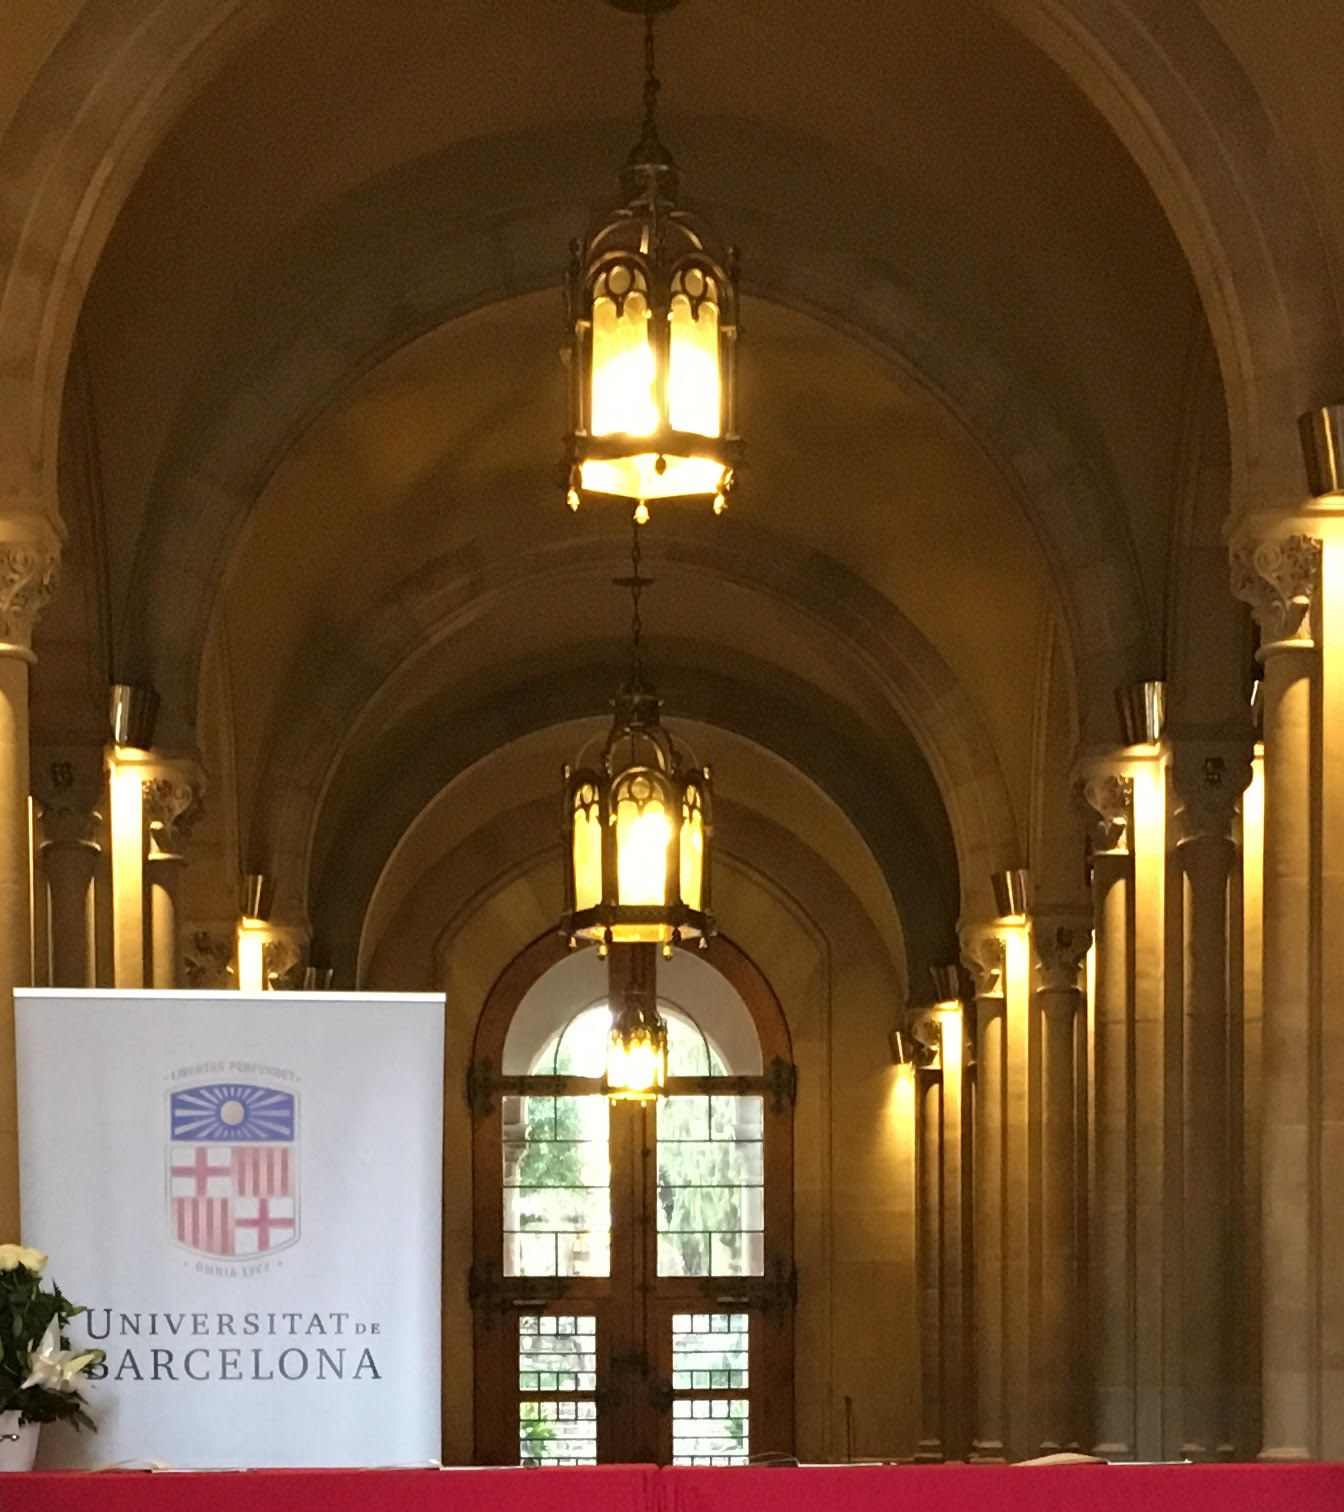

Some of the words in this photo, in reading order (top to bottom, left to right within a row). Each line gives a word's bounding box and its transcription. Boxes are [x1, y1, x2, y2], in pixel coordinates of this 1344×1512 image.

[86, 1308, 349, 1340] UNIVERSITAT
[355, 1323, 381, 1335] DE
[87, 1347, 383, 1381] BARCELONA
